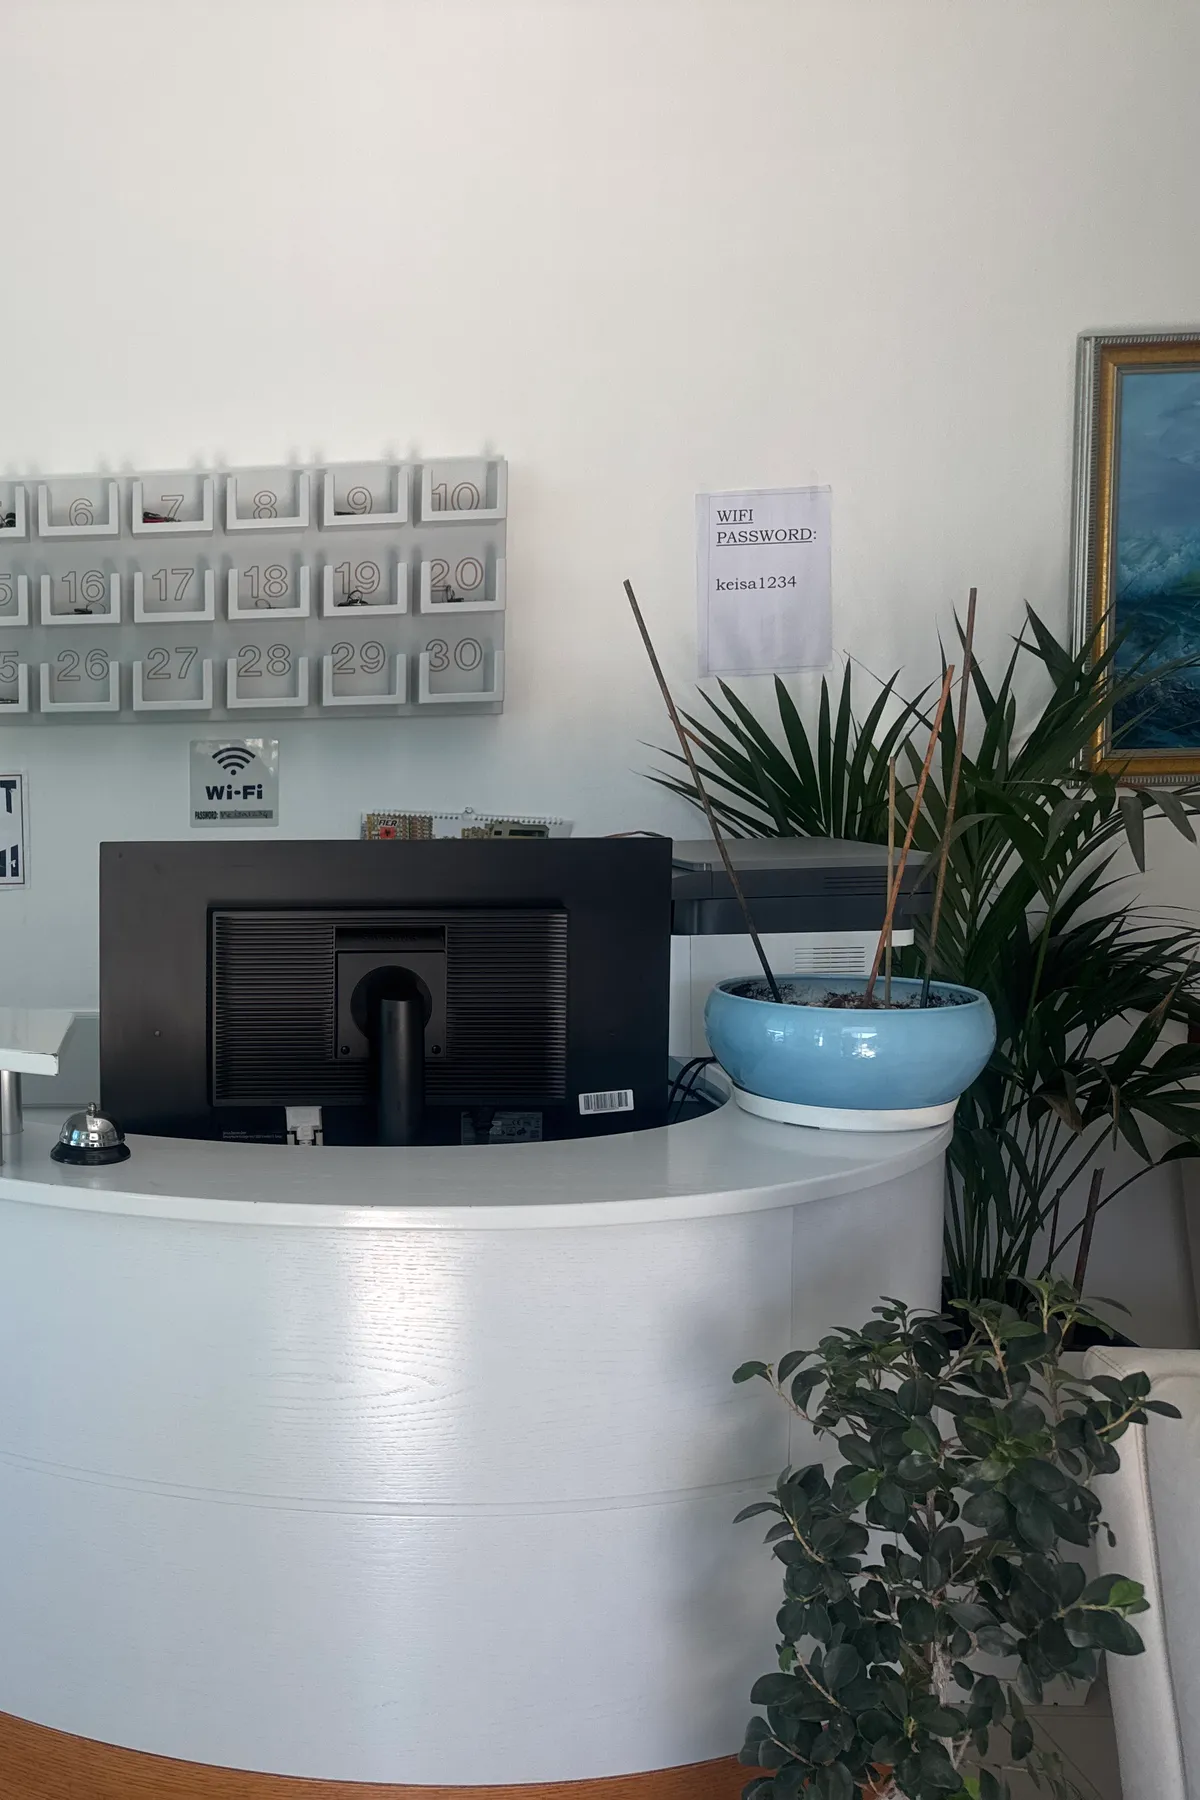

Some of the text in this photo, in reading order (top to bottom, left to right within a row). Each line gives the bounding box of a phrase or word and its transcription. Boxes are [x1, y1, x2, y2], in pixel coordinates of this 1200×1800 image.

[68, 497, 94, 527] 6
[160, 494, 185, 520] 7
[252, 490, 278, 519] 8
[346, 486, 373, 515] 9
[431, 481, 480, 511] 10
[716, 508, 754, 523] WIFI
[716, 528, 817, 544] PASSWORD:
[61, 569, 106, 604] 16
[151, 567, 195, 601] 17
[243, 564, 289, 599] 18
[334, 561, 381, 595] 19
[430, 557, 484, 592] 20
[715, 575, 797, 591] keisa1234
[56, 648, 110, 682] 26
[146, 646, 199, 680] 27
[237, 643, 292, 678] 28
[331, 641, 386, 675] 29
[426, 638, 483, 673] 30
[205, 783, 263, 801] Wi-Fi
